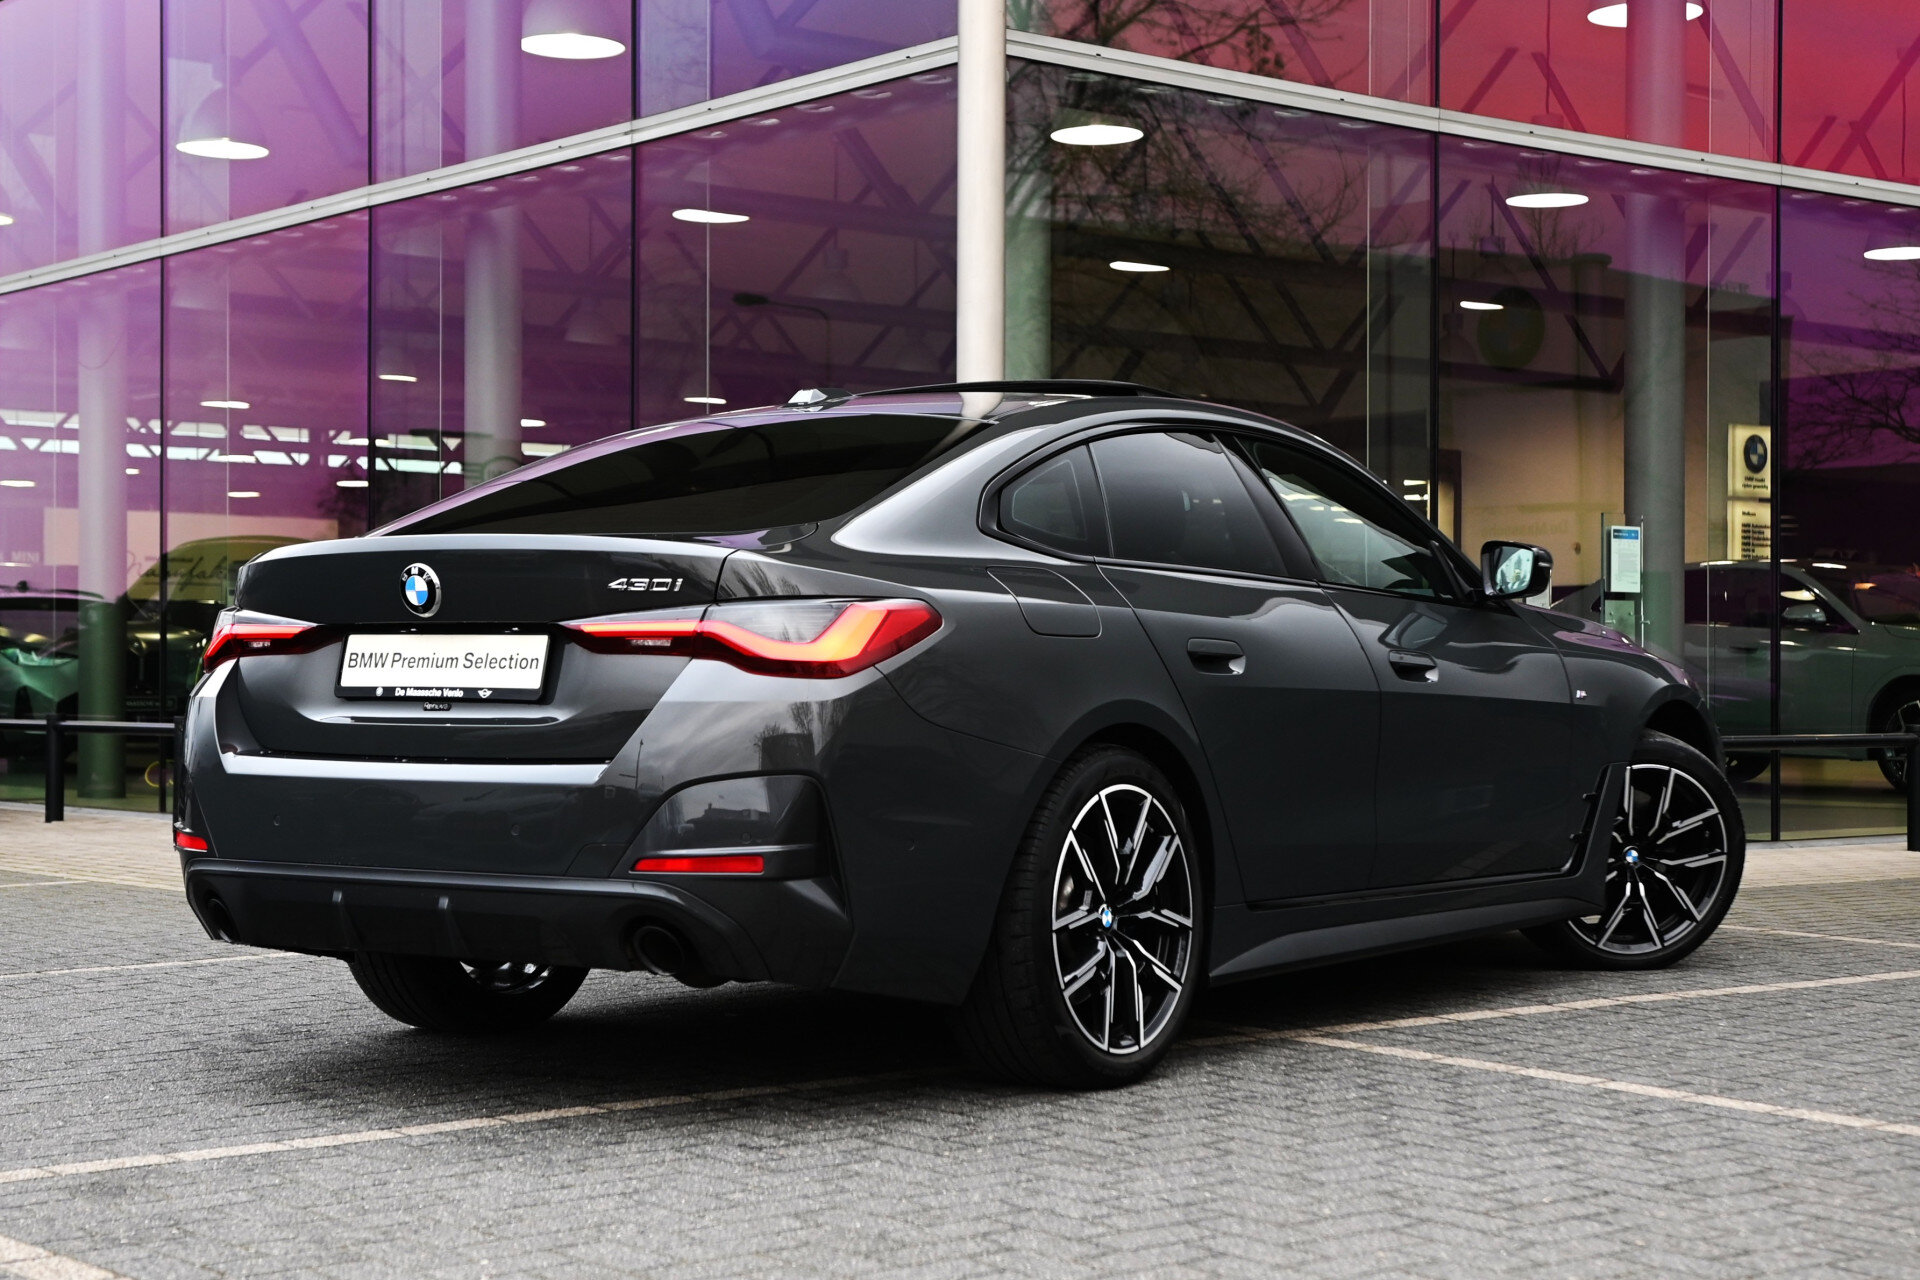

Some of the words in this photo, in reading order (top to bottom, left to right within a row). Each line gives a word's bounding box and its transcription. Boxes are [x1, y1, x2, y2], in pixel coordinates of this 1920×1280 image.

[607, 577, 684, 592] 430i
[348, 652, 390, 669] BMW
[391, 652, 459, 669] Premium
[463, 652, 540, 670] Selection
[394, 687, 405, 697] De
[443, 688, 464, 698] Venlo
